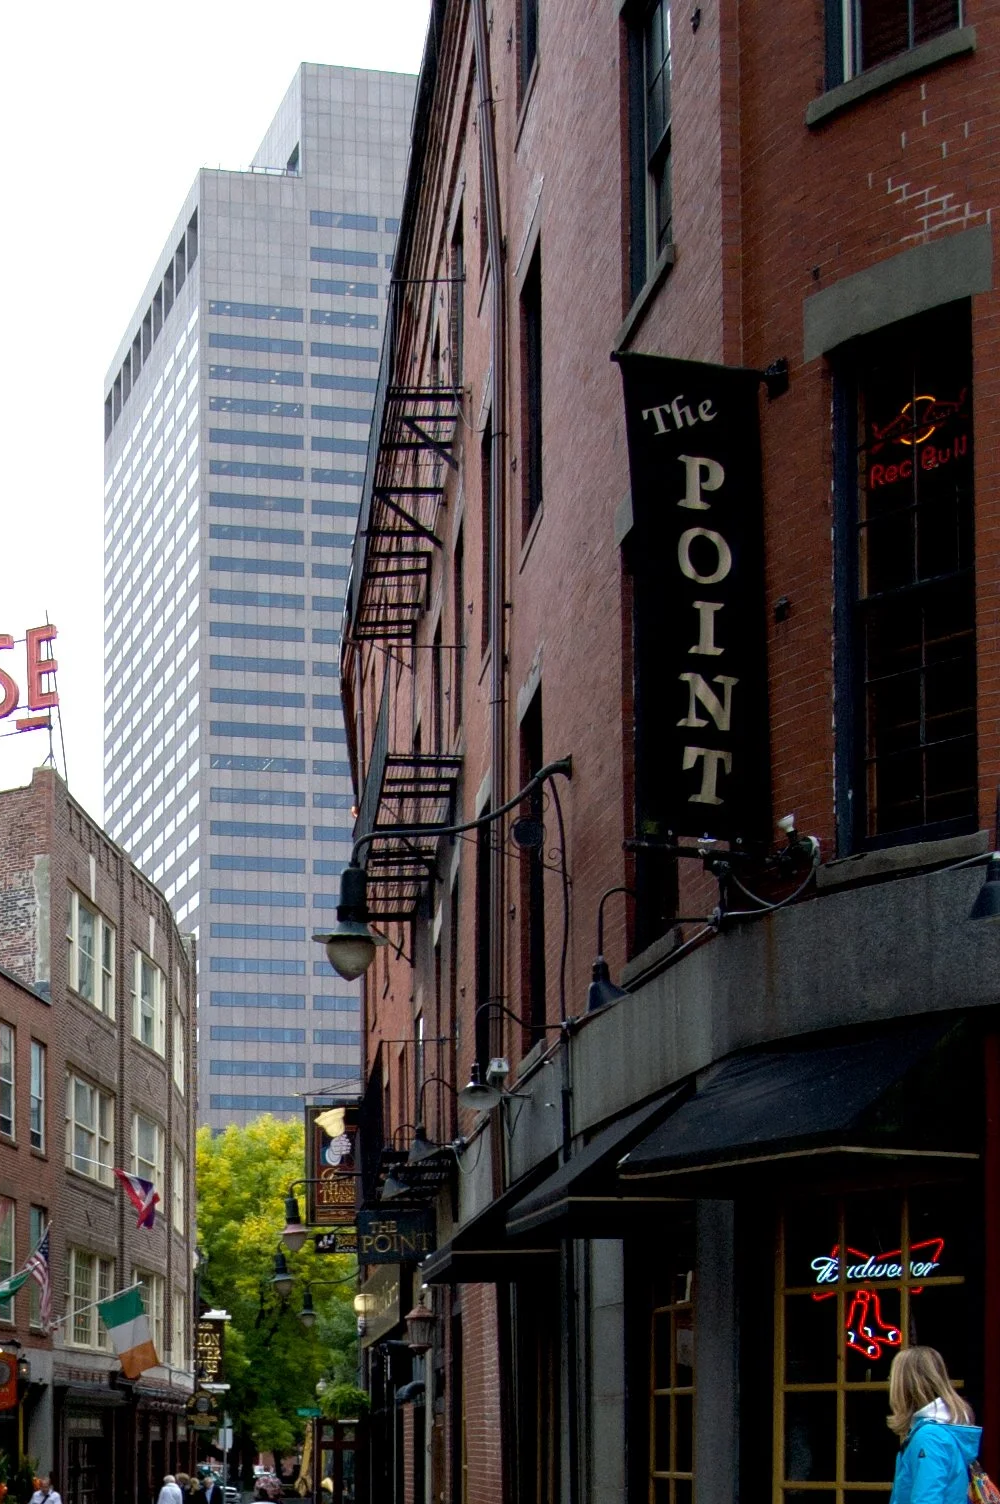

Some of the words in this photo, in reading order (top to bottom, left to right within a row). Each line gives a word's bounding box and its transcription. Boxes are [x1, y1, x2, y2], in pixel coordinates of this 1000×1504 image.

[642, 394, 718, 436] The
[921, 432, 968, 471] Bull
[676, 454, 740, 806] POINT
[360, 1230, 433, 1257] POINT
[368, 1220, 398, 1234] THE
[198, 1333, 220, 1346] ION
